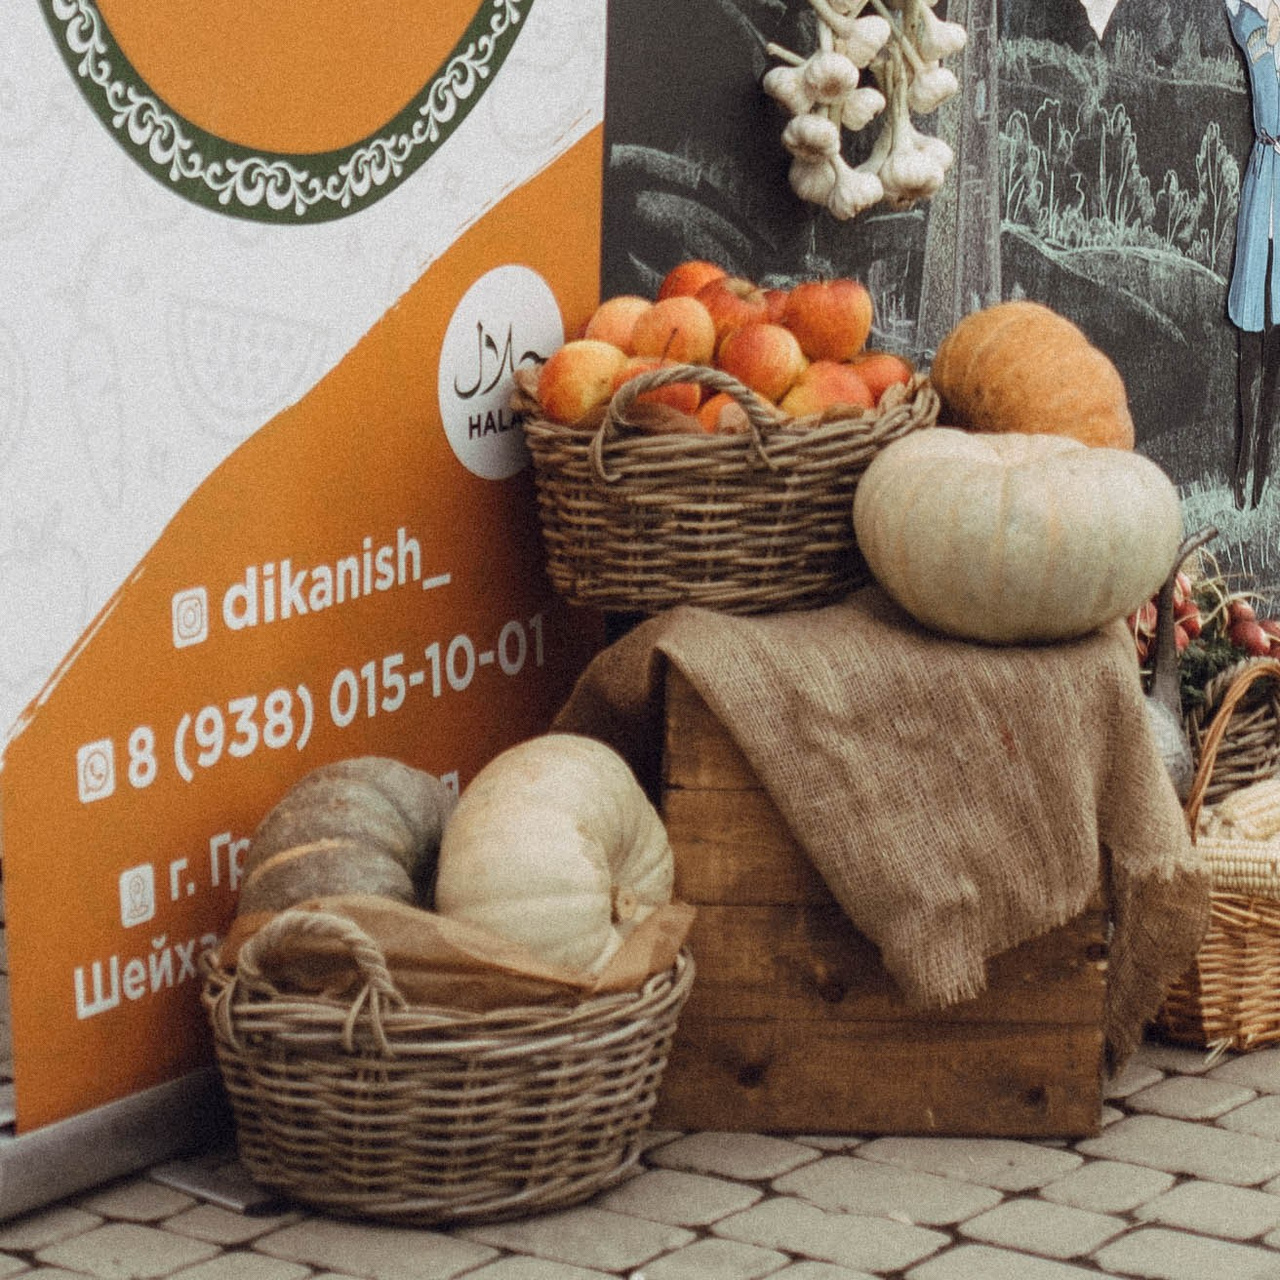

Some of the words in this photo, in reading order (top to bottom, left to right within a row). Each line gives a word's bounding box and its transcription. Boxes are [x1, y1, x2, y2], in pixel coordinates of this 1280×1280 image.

[468, 408, 526, 441] HALA
[222, 528, 452, 634] dikanish_
[127, 726, 158, 790] 8
[173, 683, 315, 782] (938)
[330, 613, 549, 727] 015-10-01
